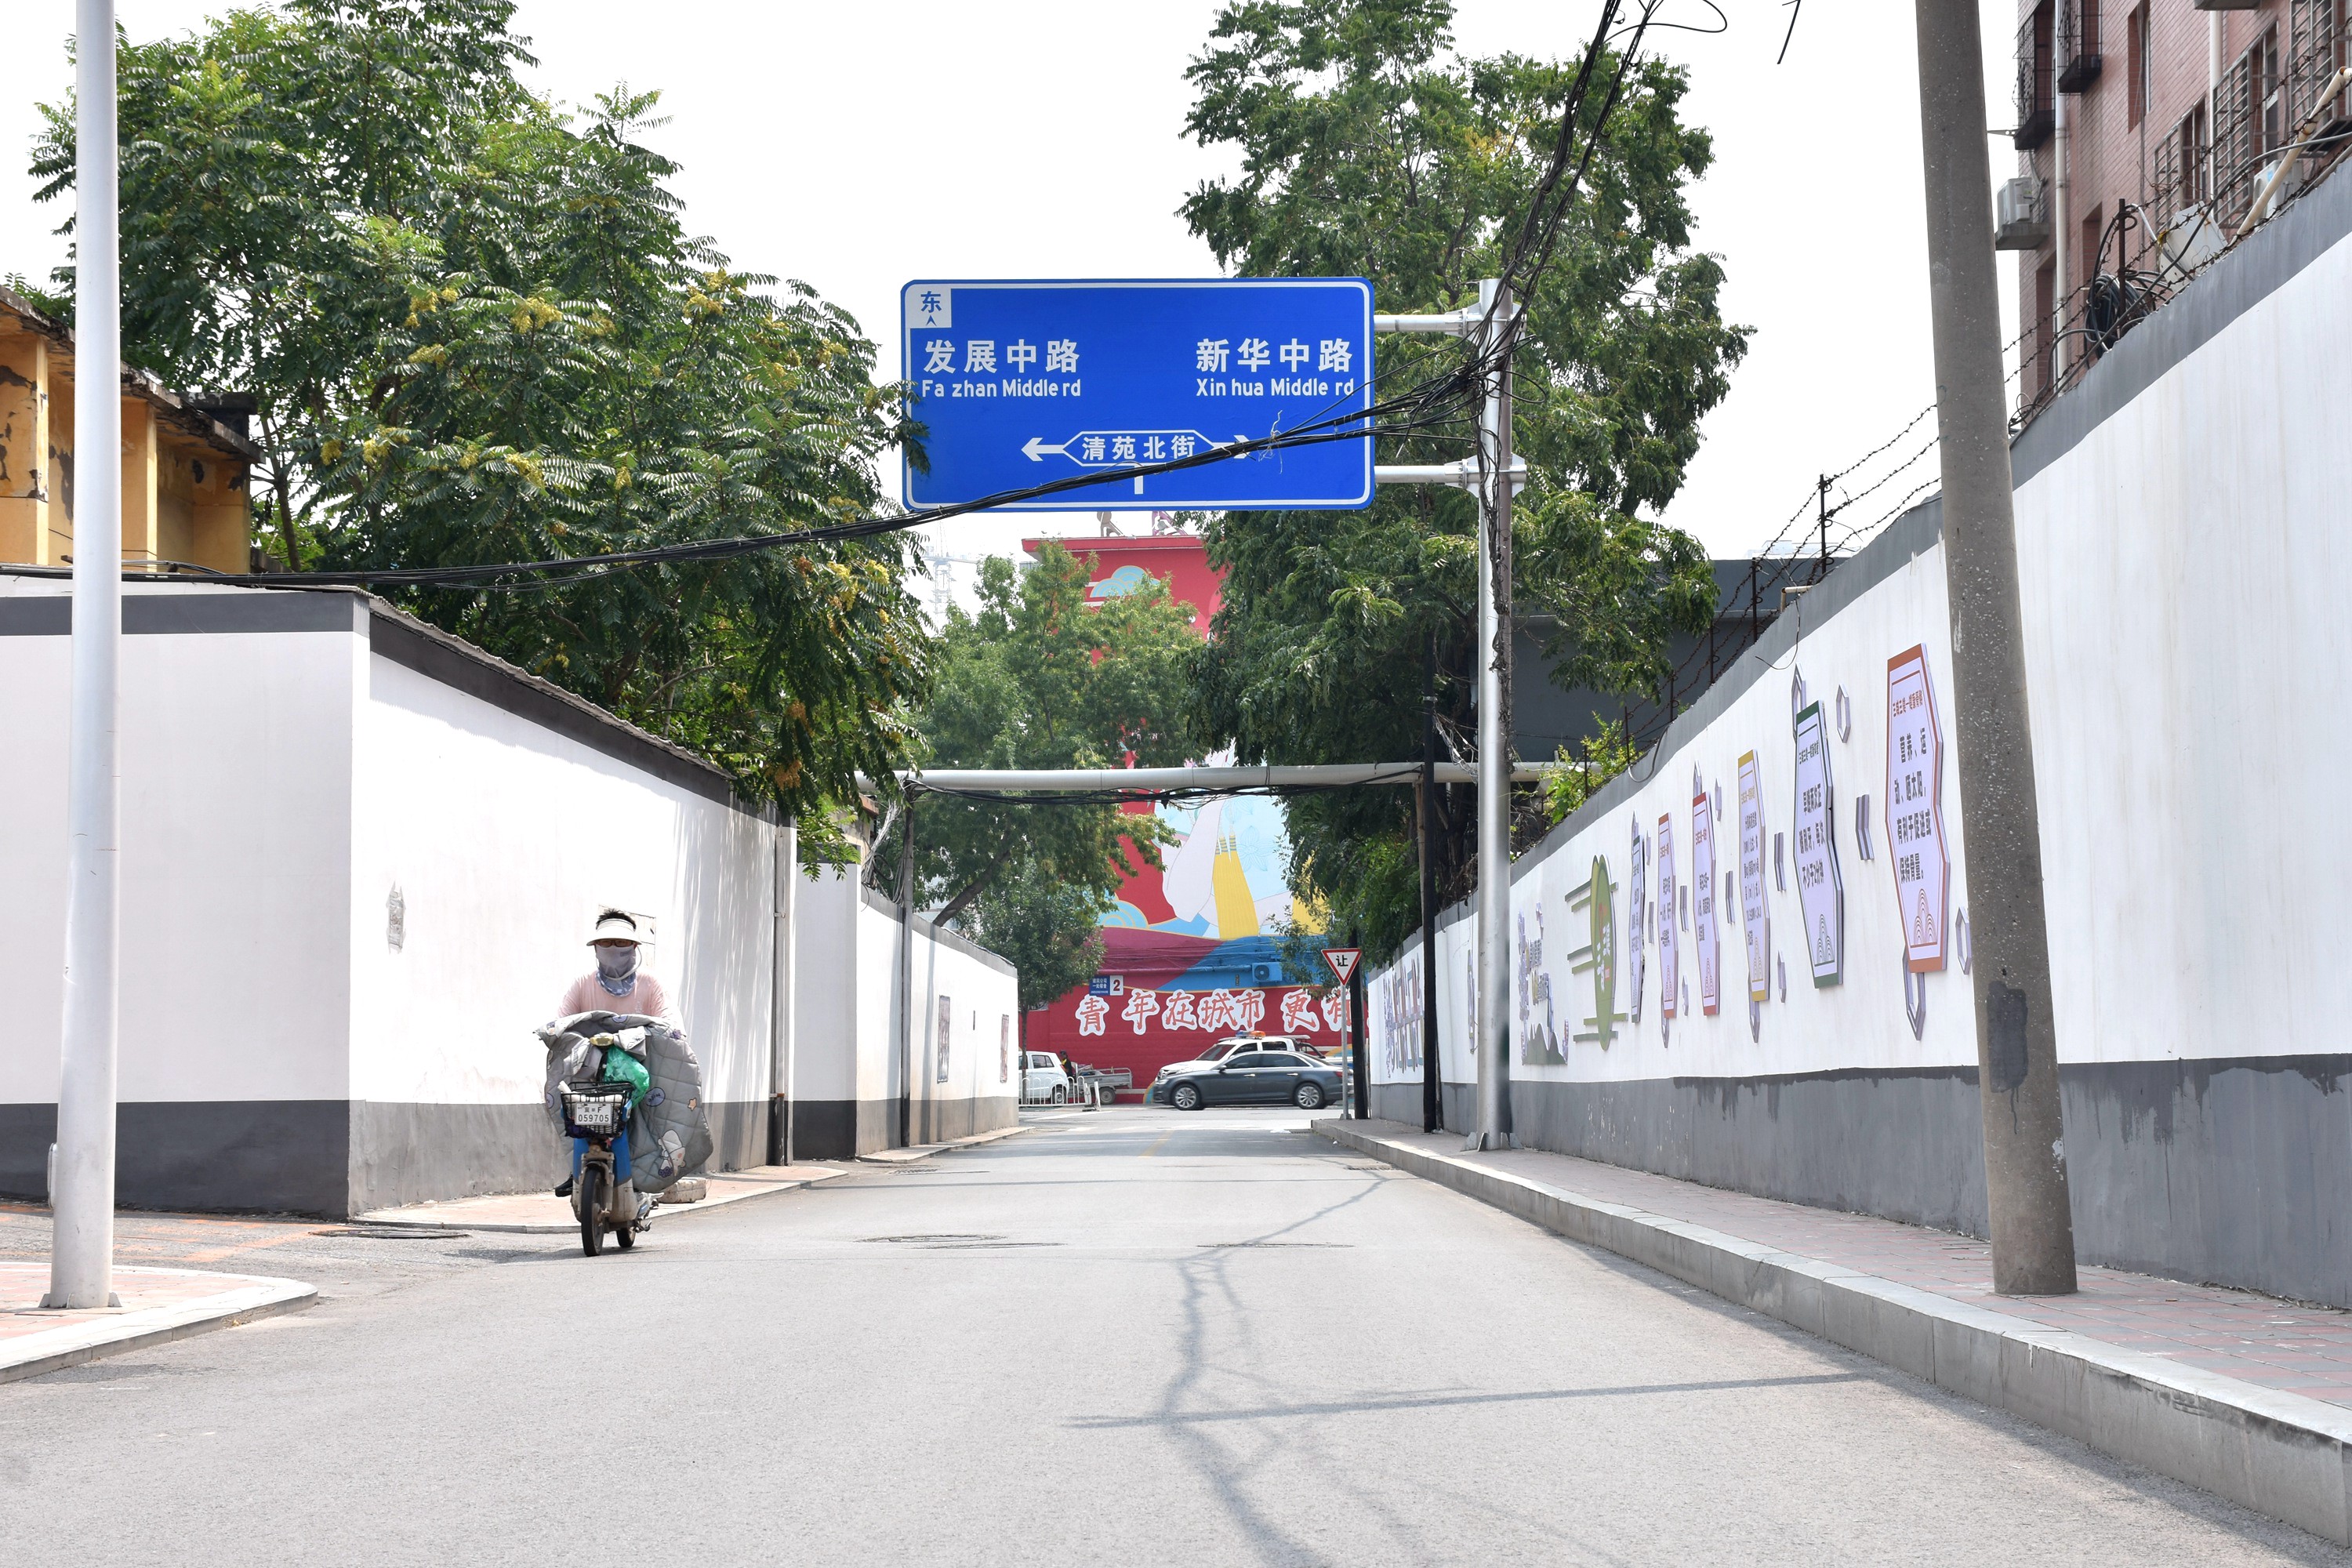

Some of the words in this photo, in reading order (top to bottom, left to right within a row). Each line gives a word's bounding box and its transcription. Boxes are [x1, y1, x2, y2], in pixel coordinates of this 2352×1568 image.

[920, 291, 942, 313] 东
[924, 339, 1080, 374] 发展中路
[1196, 338, 1353, 373] 新华中路
[922, 379, 945, 397] Fa
[952, 379, 997, 397] zhan
[1002, 378, 1058, 397] Middle
[1062, 378, 1081, 397] rd
[1196, 378, 1226, 397] Xin
[1231, 377, 1264, 397] hua
[1271, 377, 1329, 397] Middle
[1335, 378, 1354, 397] rd
[1082, 434, 1196, 460] 清苑北街
[1335, 954, 1348, 967] 让
[1112, 979, 1120, 992] 2
[578, 1114, 609, 1123] 059705
